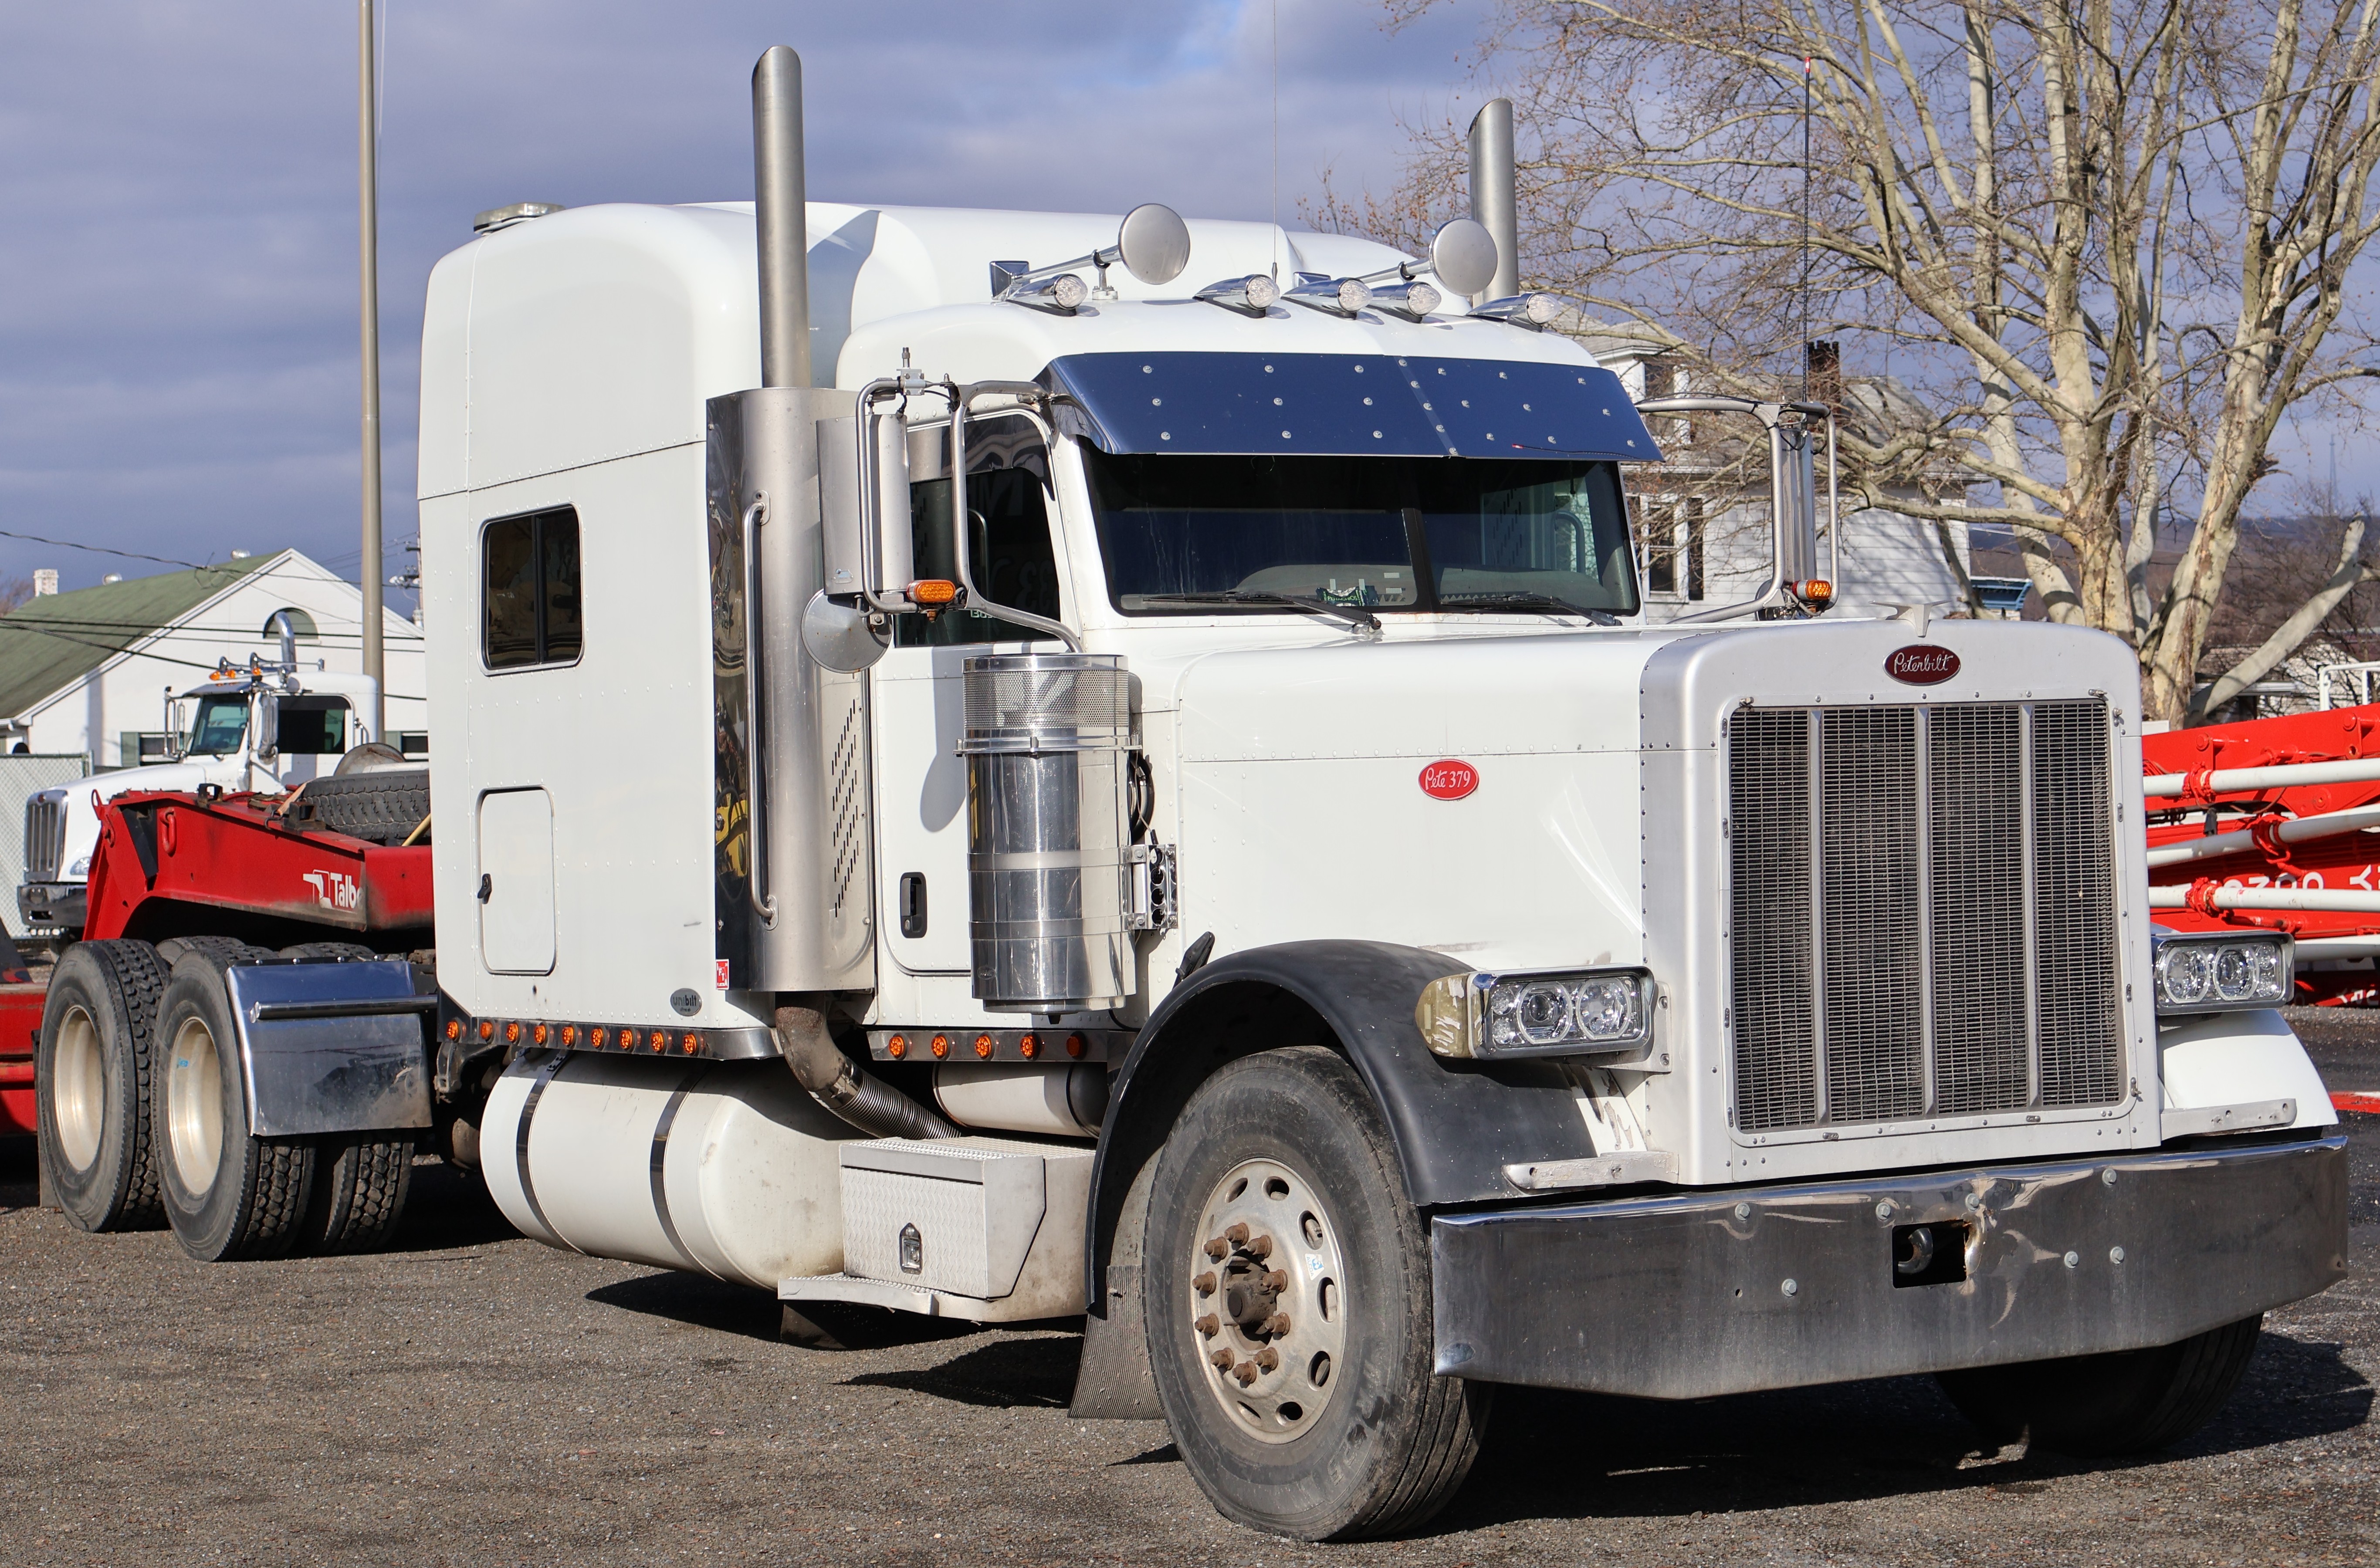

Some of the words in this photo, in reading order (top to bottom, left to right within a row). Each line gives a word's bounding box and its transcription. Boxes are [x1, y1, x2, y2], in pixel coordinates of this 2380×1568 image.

[1893, 652, 1953, 675] Peterbilt
[1425, 767, 1447, 791] Pete
[1449, 770, 1471, 788] 379
